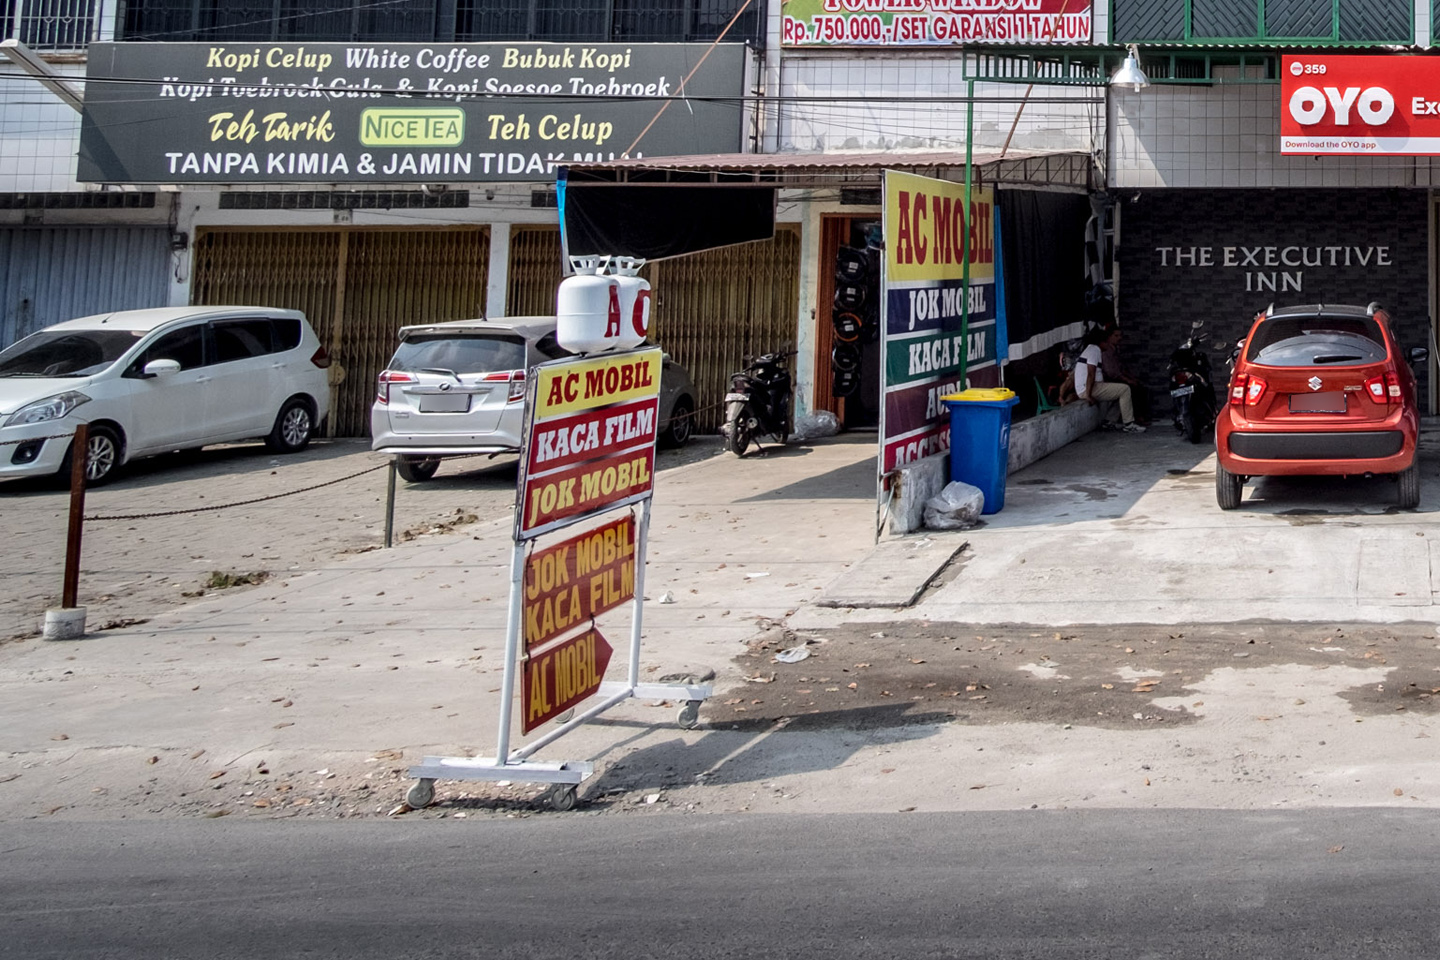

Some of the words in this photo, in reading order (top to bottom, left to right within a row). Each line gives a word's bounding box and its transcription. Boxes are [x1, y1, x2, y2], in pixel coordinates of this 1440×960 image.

[783, 16, 811, 43] Rp.
[933, 14, 1015, 41] GARANSI
[1015, 14, 1029, 40] 1
[1030, 13, 1092, 41] TAHUN
[206, 47, 261, 72] Kopi
[265, 47, 332, 72] Celup
[346, 47, 411, 69] White
[416, 48, 490, 72] Coffee
[502, 48, 575, 69] Bubuk
[579, 48, 632, 72] Kopi
[1304, 64, 1327, 75] 359
[159, 77, 214, 102] Kopi
[426, 77, 479, 102] Kopi
[569, 76, 670, 97] Toebroek
[1288, 86, 1395, 126] OYO
[208, 109, 260, 143] Teh
[262, 109, 336, 143] Tarik
[487, 114, 532, 140] Teh
[538, 113, 613, 145] Celup
[1285, 140, 1326, 150] Download
[1326, 141, 1340, 149] the
[1341, 141, 1360, 149] OYO
[1361, 142, 1377, 151] app
[165, 152, 259, 175] TANPA
[267, 152, 349, 175] KIMIA
[356, 152, 375, 175] &
[382, 152, 472, 175] JAMIN
[896, 191, 928, 266] AC
[932, 196, 993, 266] MOBIL
[1155, 246, 1215, 267] THE
[1223, 246, 1393, 267] EXECUTIVE
[1245, 271, 1303, 292] INN
[909, 288, 939, 331] JOK
[942, 285, 987, 321] MOBIL
[908, 338, 951, 376] KACA
[952, 331, 985, 367] FLM
[547, 373, 579, 406] AC
[584, 361, 652, 399] MOBIL
[536, 421, 600, 463] KACA
[603, 407, 655, 446] FILM
[528, 477, 577, 528] JOK
[579, 456, 650, 503] MOBIL
[527, 545, 570, 600] JOK
[576, 521, 635, 578] MOBIL
[526, 584, 582, 644] KACA
[590, 559, 635, 613] FILM
[529, 655, 552, 723] AC
[555, 632, 600, 708] MOBIL
